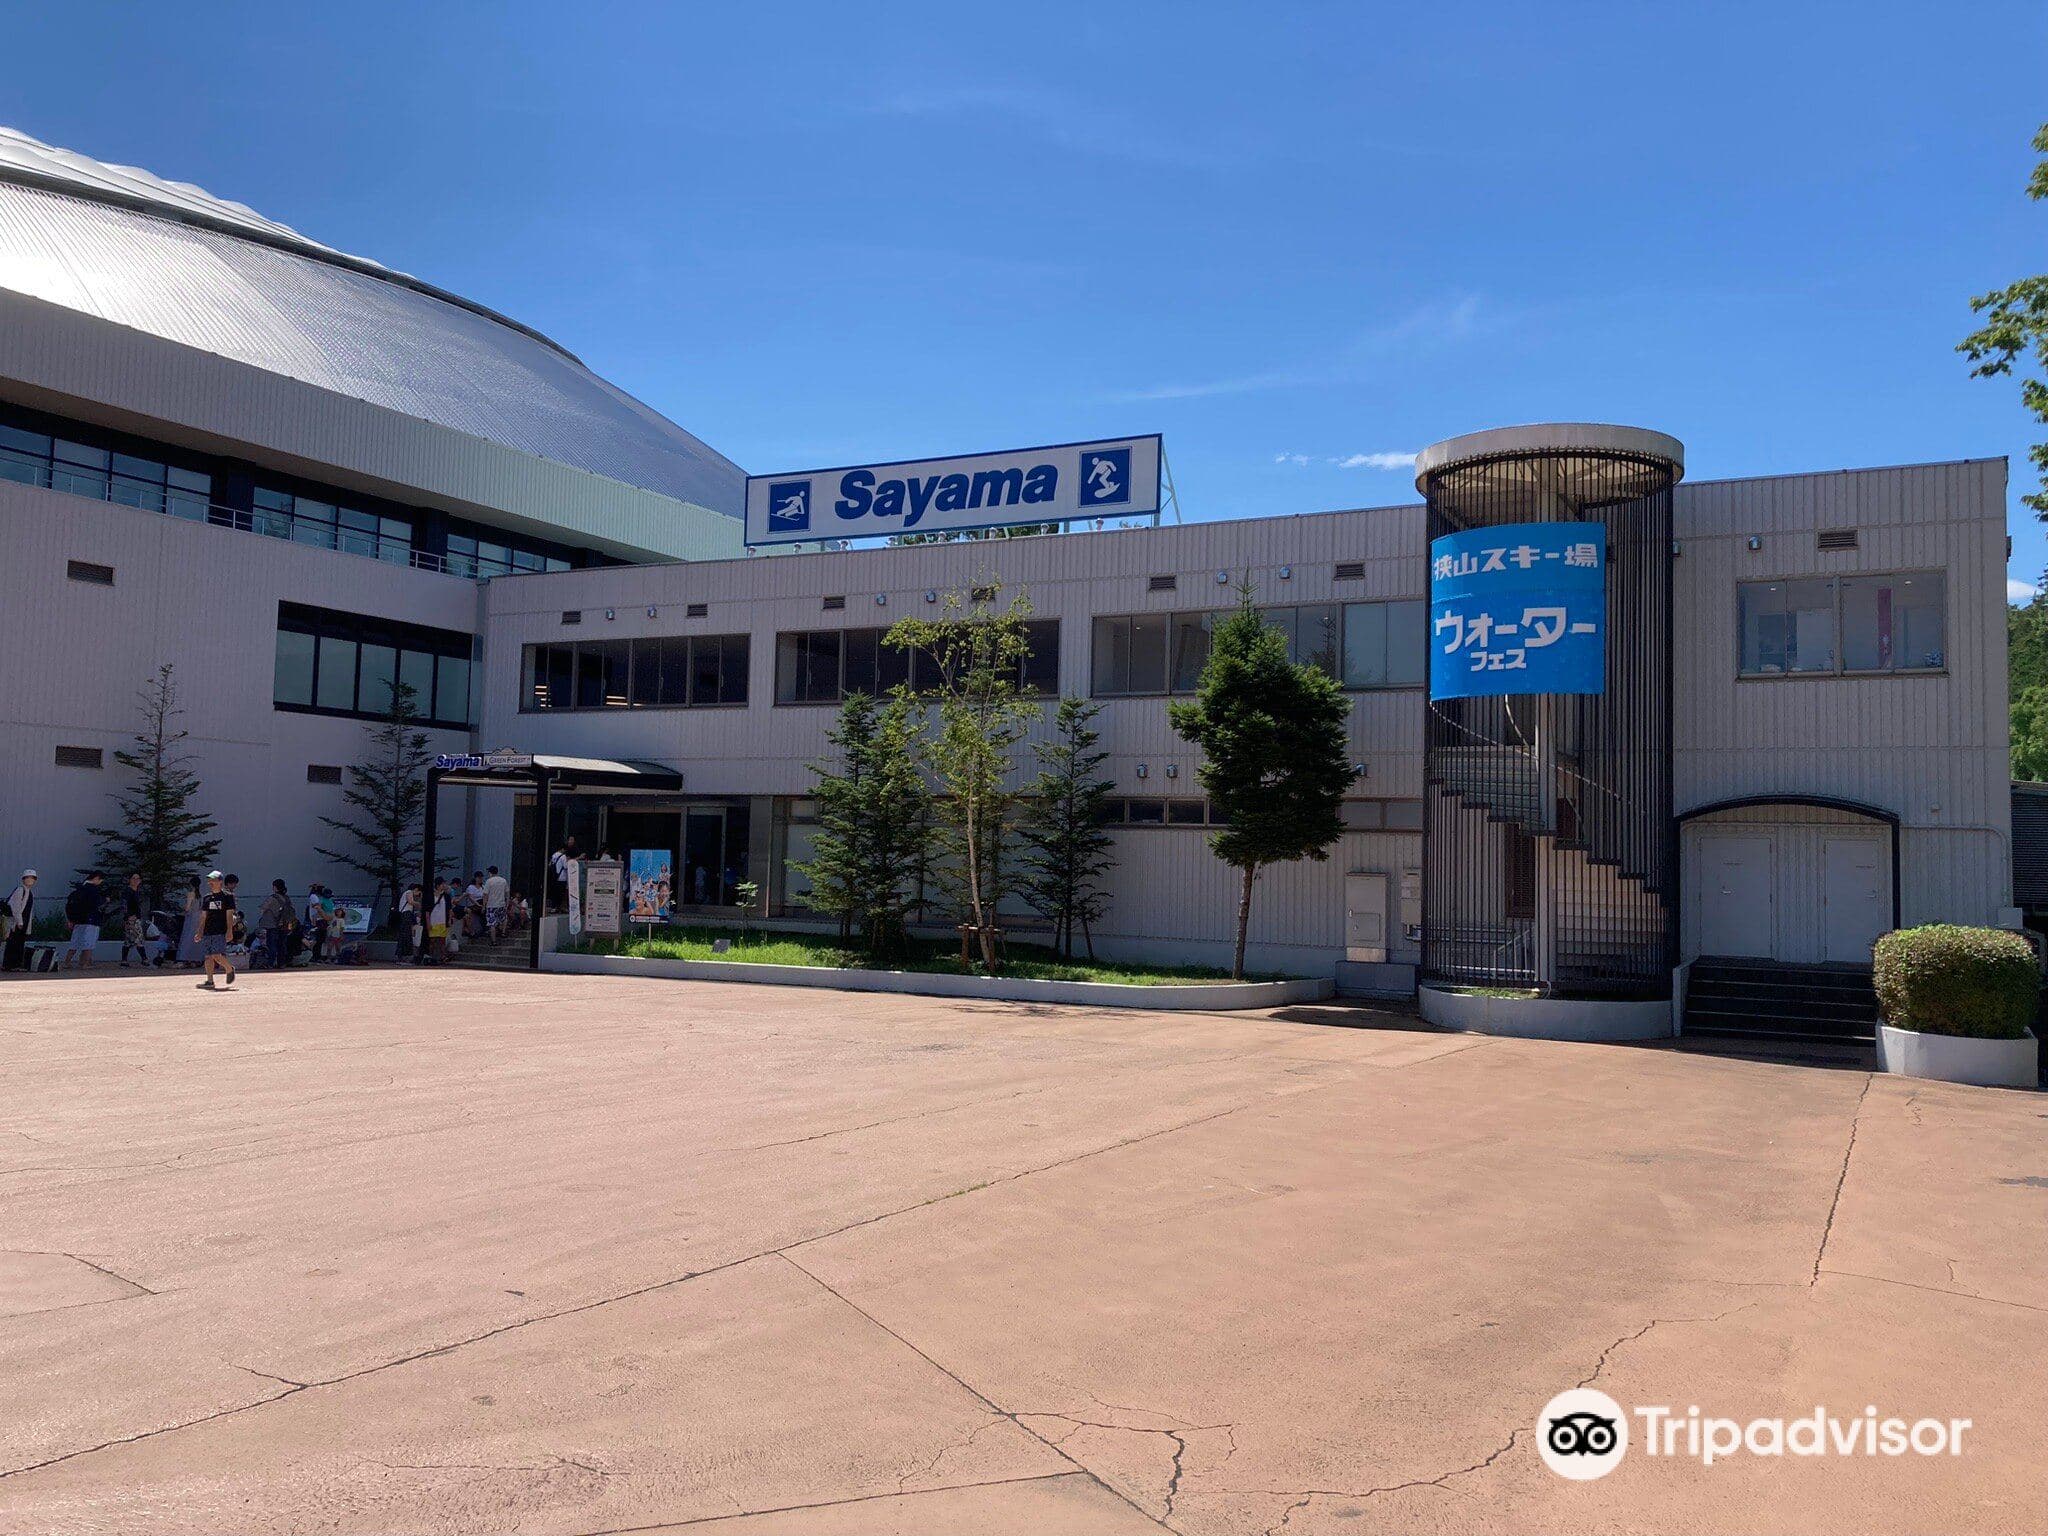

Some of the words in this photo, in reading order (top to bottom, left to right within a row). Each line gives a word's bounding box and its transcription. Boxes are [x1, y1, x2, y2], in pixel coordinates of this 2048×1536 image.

[834, 463, 1059, 528] Sayama
[1434, 543, 1599, 581] 狭山スキー場
[1435, 606, 1597, 655] ウォーター
[1470, 649, 1527, 672] フェス
[436, 754, 481, 770] Sayama
